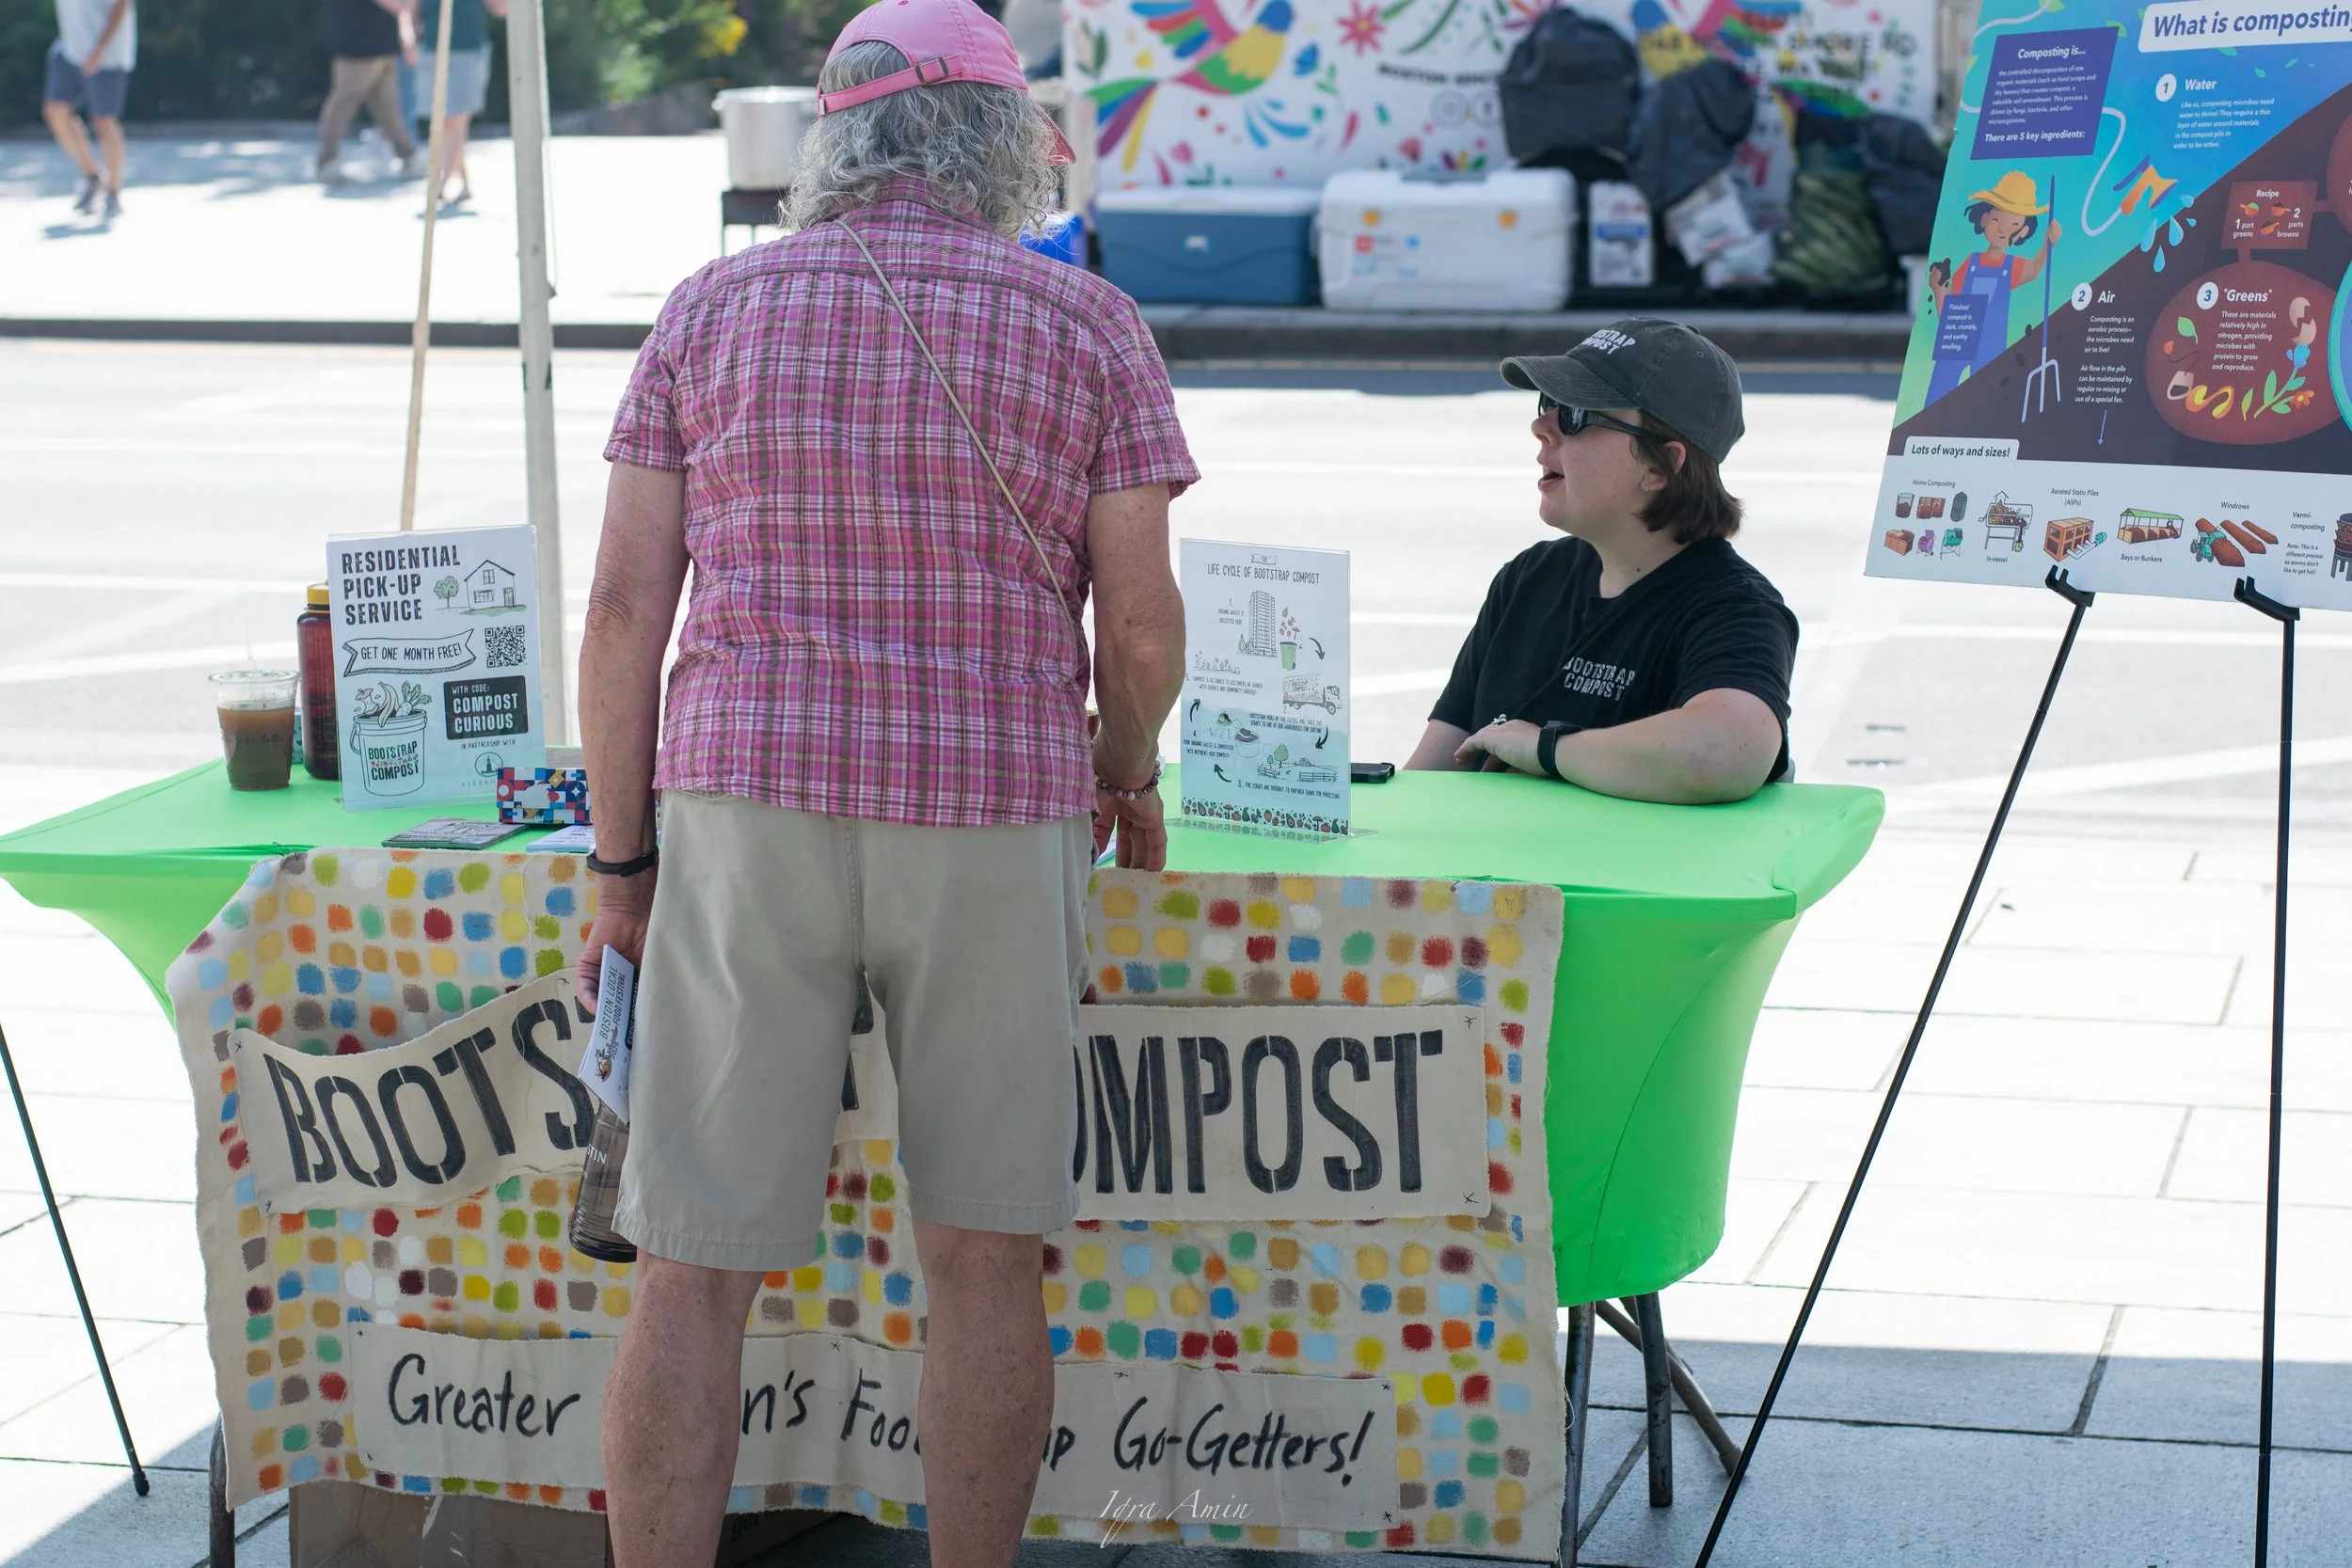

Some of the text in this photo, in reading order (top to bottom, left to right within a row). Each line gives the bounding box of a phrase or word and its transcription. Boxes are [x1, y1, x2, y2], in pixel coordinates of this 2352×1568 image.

[2154, 5, 2352, 37] What is compostin
[2018, 46, 2069, 60] Composting
[2164, 79, 2217, 94] 1 Water
[1985, 133, 2005, 142] There
[2020, 132, 2026, 140] 5
[2026, 132, 2040, 142] key
[2041, 130, 2086, 141] ingredients:
[2256, 189, 2279, 198] Recipe
[2294, 207, 2301, 218] 2
[2235, 218, 2241, 229] 1
[2078, 290, 2116, 303] 2 Air
[2204, 288, 2273, 302] 3 "Greens"
[2219, 321, 2246, 330] relatively
[2247, 321, 2260, 330] high
[2245, 332, 2273, 341] providing
[2214, 353, 2235, 361] protein
[2095, 396, 2113, 404] special
[1912, 444, 2010, 458] Lots of ways and sizes!
[1928, 480, 1956, 489] Composting
[2221, 501, 2249, 510] Windrows
[2291, 523, 2326, 532] composting
[342, 545, 461, 575] RESIDENTIAL
[2121, 553, 2134, 562] Bays
[2141, 554, 2163, 562] Bunkers
[1208, 563, 1320, 584] LIFE CYCLE OF BOOTSTRAP COMPOST
[343, 573, 421, 600] PICK-UP
[345, 598, 422, 626] SERVICE
[361, 642, 462, 660] GET ONE MONTH FREE!
[453, 684, 490, 695] WITH CODE:
[1564, 673, 1625, 701] COMPOST
[453, 693, 518, 714] COMPOST
[454, 713, 514, 734] CURIOUS
[368, 740, 418, 760] BOOTSTRAP
[468, 739, 501, 749] PARTNERSHIP
[371, 760, 419, 781] COMPOST
[599, 965, 618, 1040] BOSTON LOCAL
[613, 972, 626, 1026] FOOD FESTIVAL
[1073, 1029, 1443, 1195] MPOST
[388, 1353, 581, 1438] Greater
[840, 1367, 921, 1456] Foo
[1114, 1396, 1375, 1487] Go-Getters!
